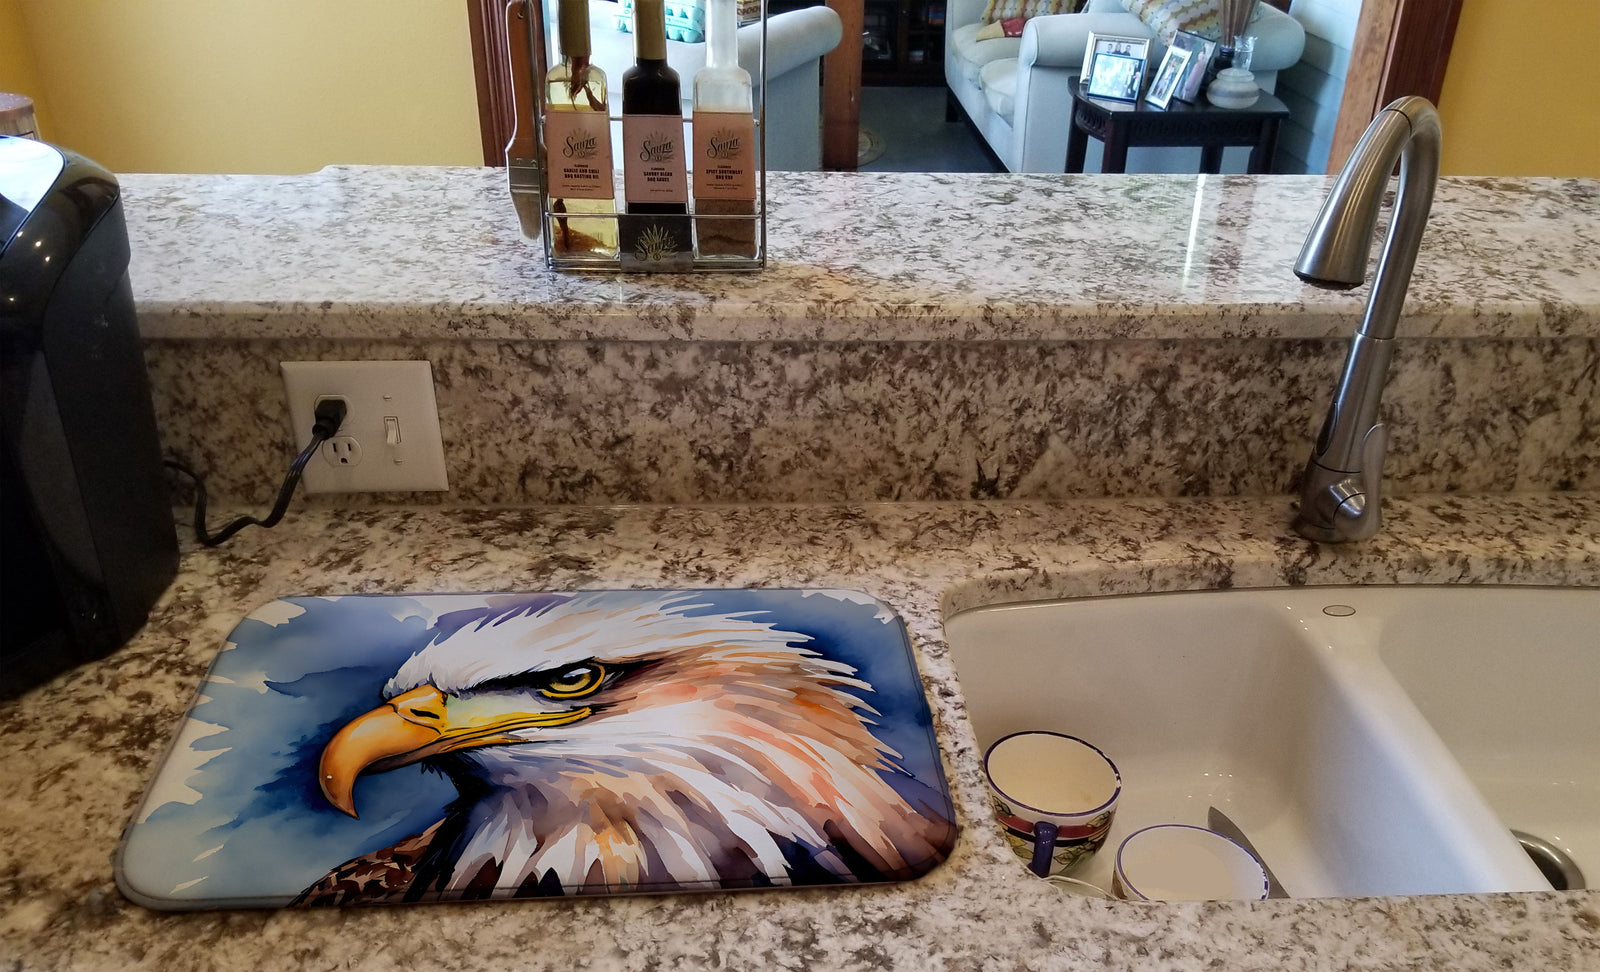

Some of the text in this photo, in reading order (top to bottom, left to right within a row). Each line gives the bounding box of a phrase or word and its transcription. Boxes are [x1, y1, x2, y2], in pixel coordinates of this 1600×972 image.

[563, 136, 598, 158] Sauza
[640, 140, 674, 161] Sauza
[706, 136, 740, 158] Sauza
